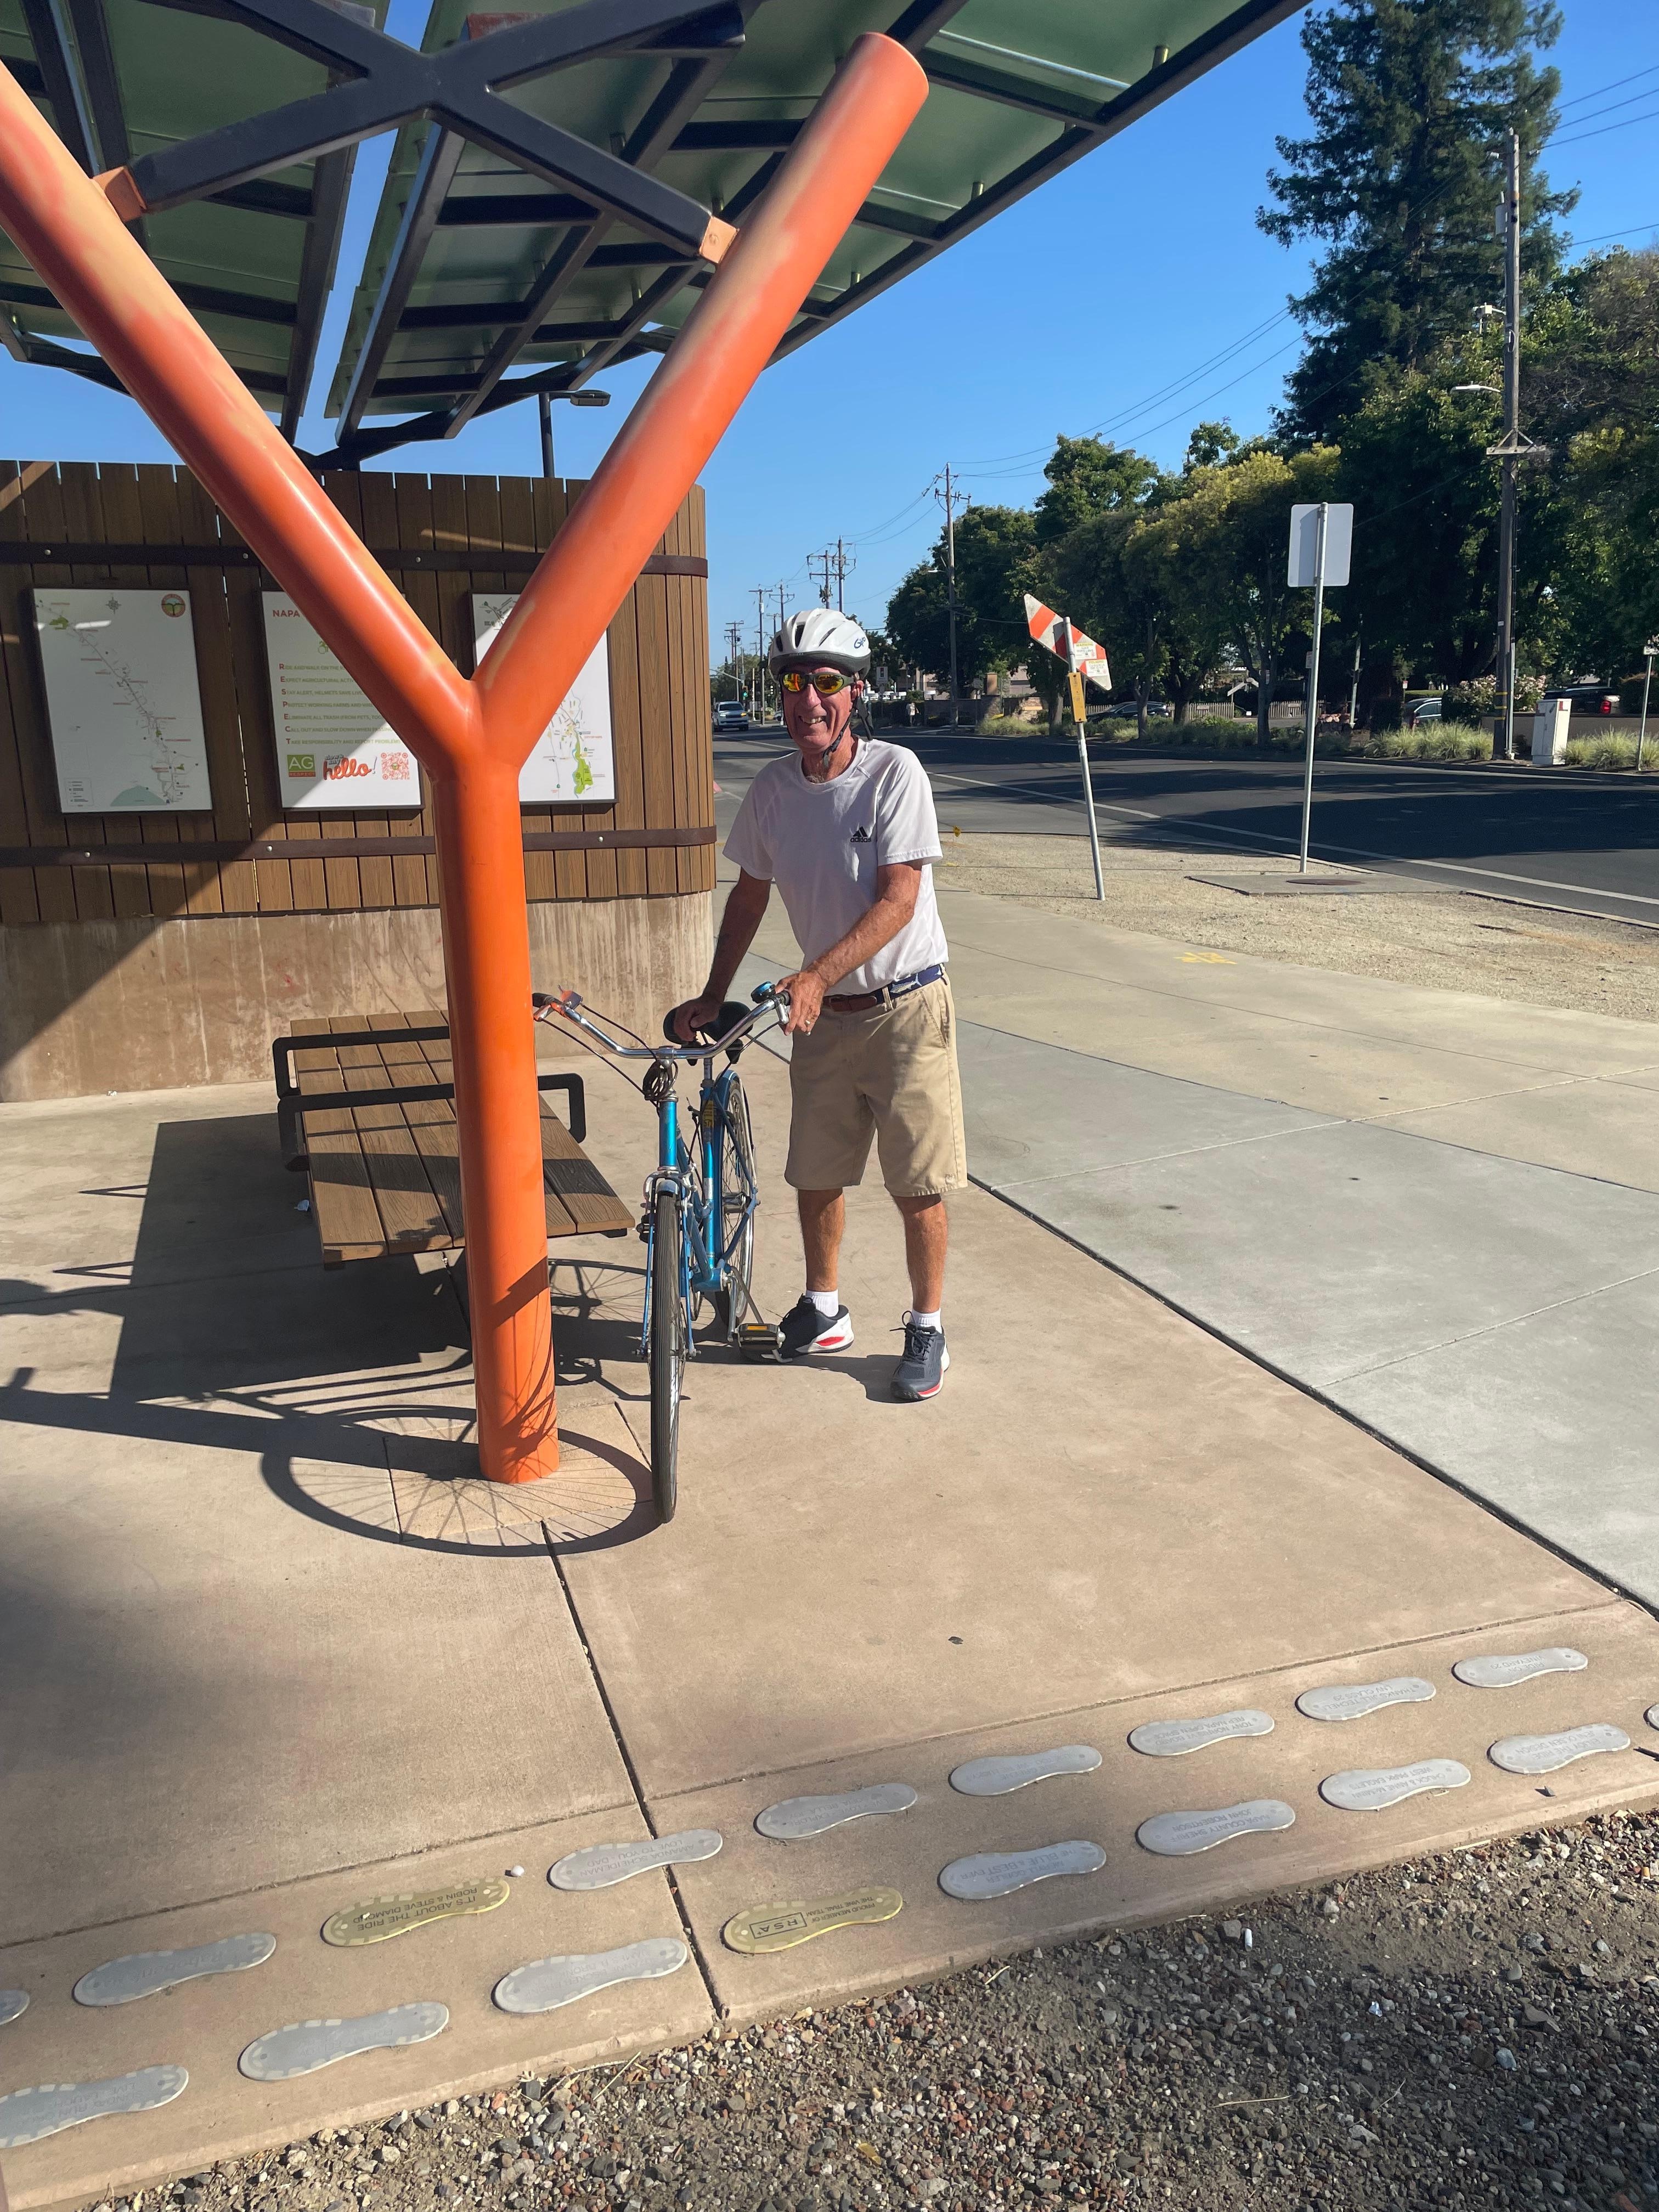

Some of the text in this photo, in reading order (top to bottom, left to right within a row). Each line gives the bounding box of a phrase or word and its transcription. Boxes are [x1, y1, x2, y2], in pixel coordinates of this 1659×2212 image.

[289, 757, 313, 769] AG
[1206, 1720, 1227, 1729] NAPA
[1172, 1814, 1227, 1832] ROBERTSON
[1209, 1820, 1245, 1832] COUNTY
[641, 1846, 655, 1854] TO
[657, 1839, 682, 1850] LOVE
[618, 1850, 637, 1860] YOU
[651, 1844, 694, 1860] AMANDA
[587, 1857, 608, 1867] DAD
[988, 1862, 1017, 1875] BEST
[446, 1887, 477, 1900] ROBIN
[404, 1898, 434, 1911] STEVE
[825, 1903, 844, 1912] TRAIL
[851, 1903, 876, 1913] PROUD
[358, 1895, 476, 1931] IT'S ABOUT THE RIDE
[805, 1908, 823, 1917] TEAM
[820, 1908, 851, 1921] MEMBER
